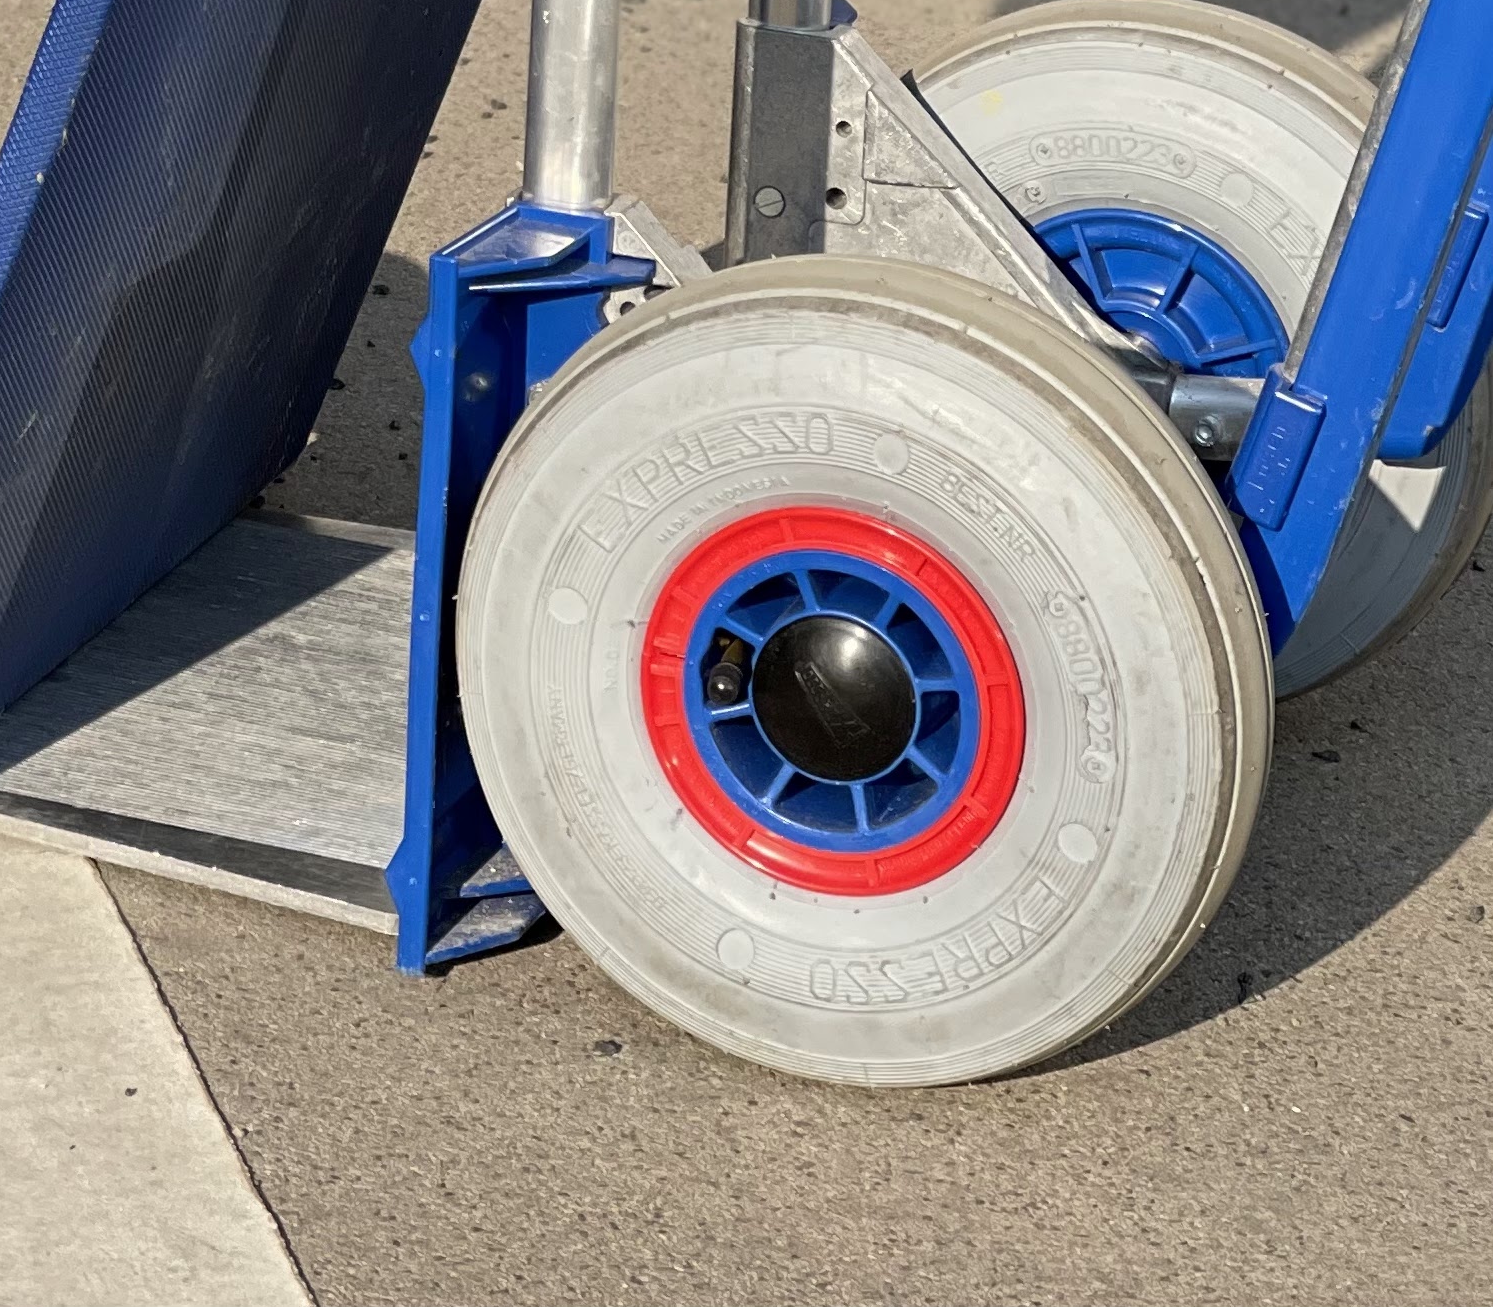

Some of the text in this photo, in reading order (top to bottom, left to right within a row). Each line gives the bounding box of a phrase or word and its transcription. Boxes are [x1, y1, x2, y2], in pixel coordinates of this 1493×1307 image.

[579, 409, 835, 553] EXPRESSO
[657, 515, 691, 544] MADE
[809, 873, 1068, 1006] EXPRESSO
